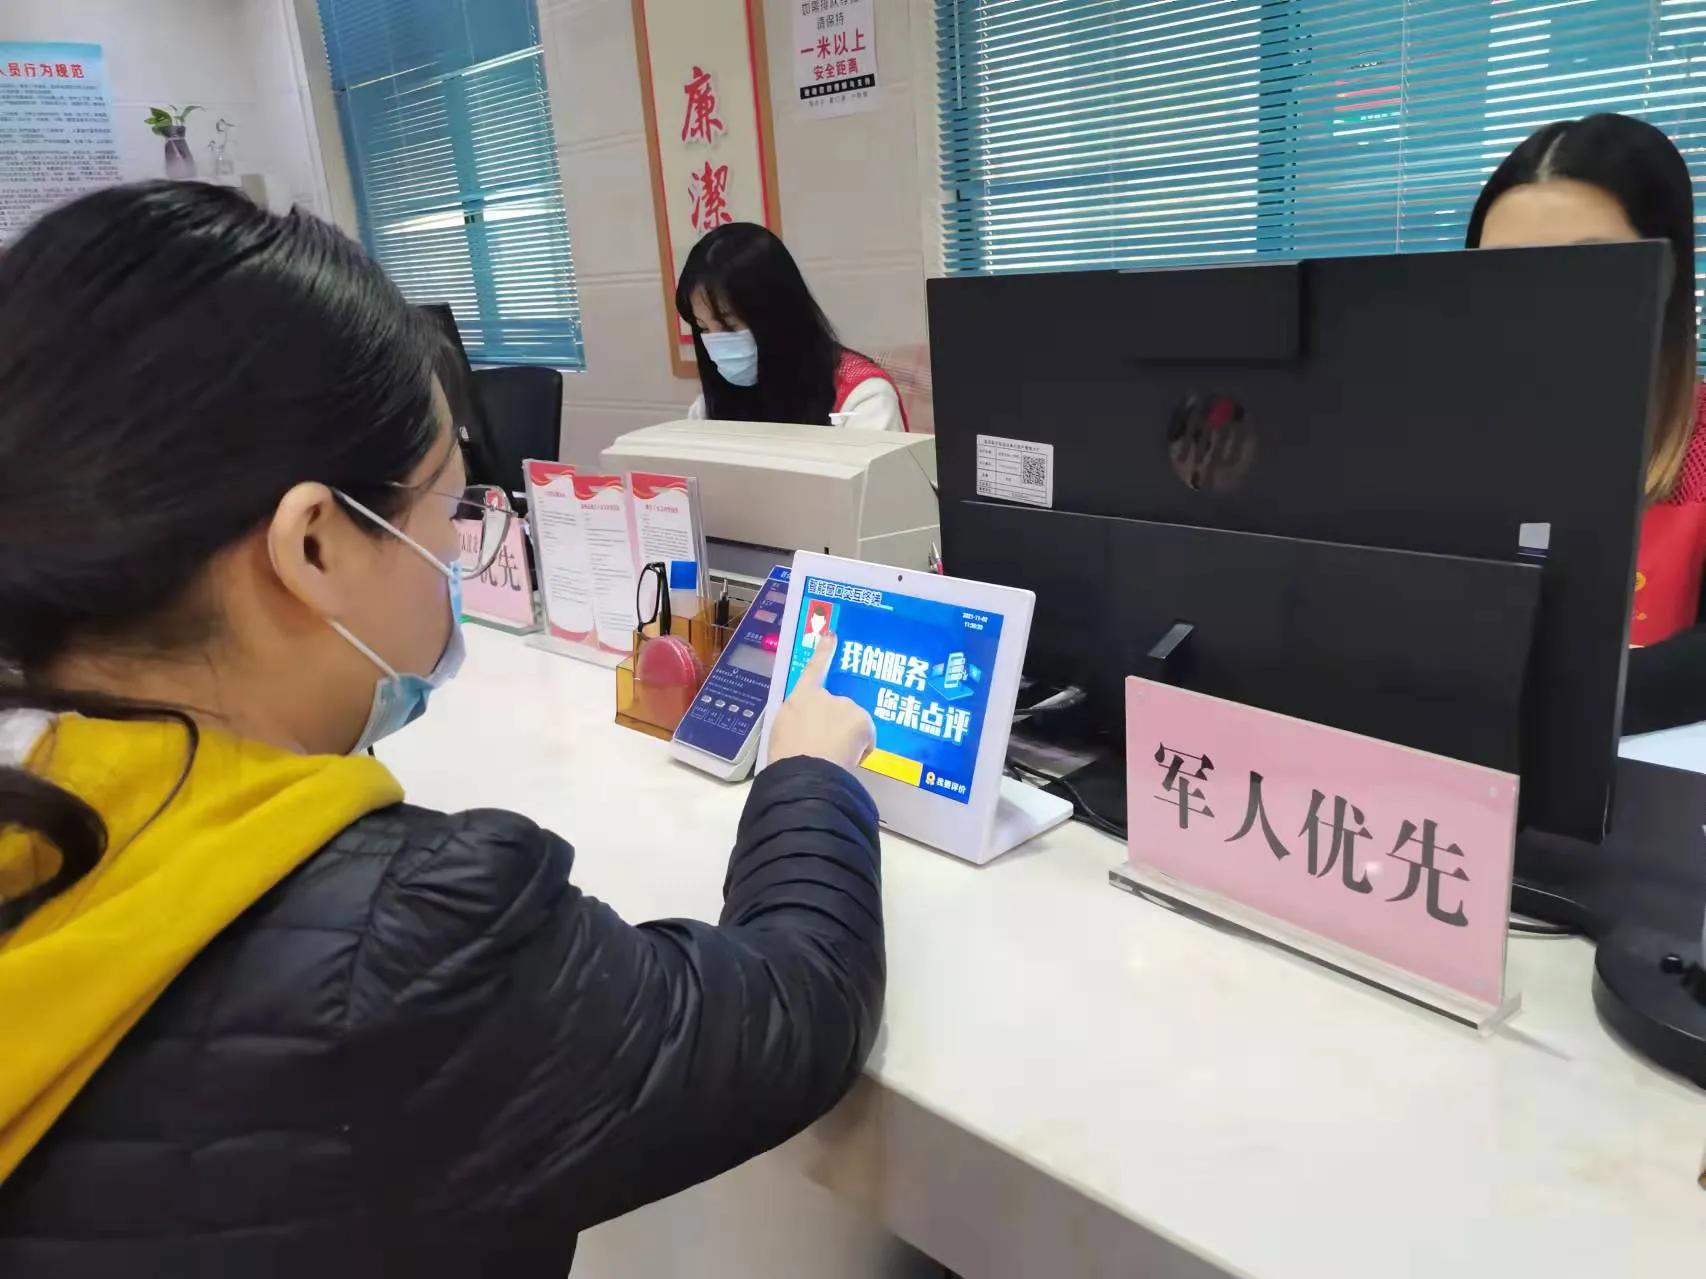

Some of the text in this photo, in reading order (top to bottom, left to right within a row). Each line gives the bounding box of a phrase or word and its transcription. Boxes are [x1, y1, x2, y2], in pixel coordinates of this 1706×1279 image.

[816, 12, 845, 30] 请保持
[800, 27, 866, 59] 一米以上
[814, 57, 858, 81] 安全距离
[808, 579, 882, 605] 智能窗口交互终端
[841, 641, 928, 691] 我的服务
[876, 687, 969, 743] 您来点评
[936, 777, 966, 794] 我要评价
[1153, 742, 1470, 927] 军人优先
